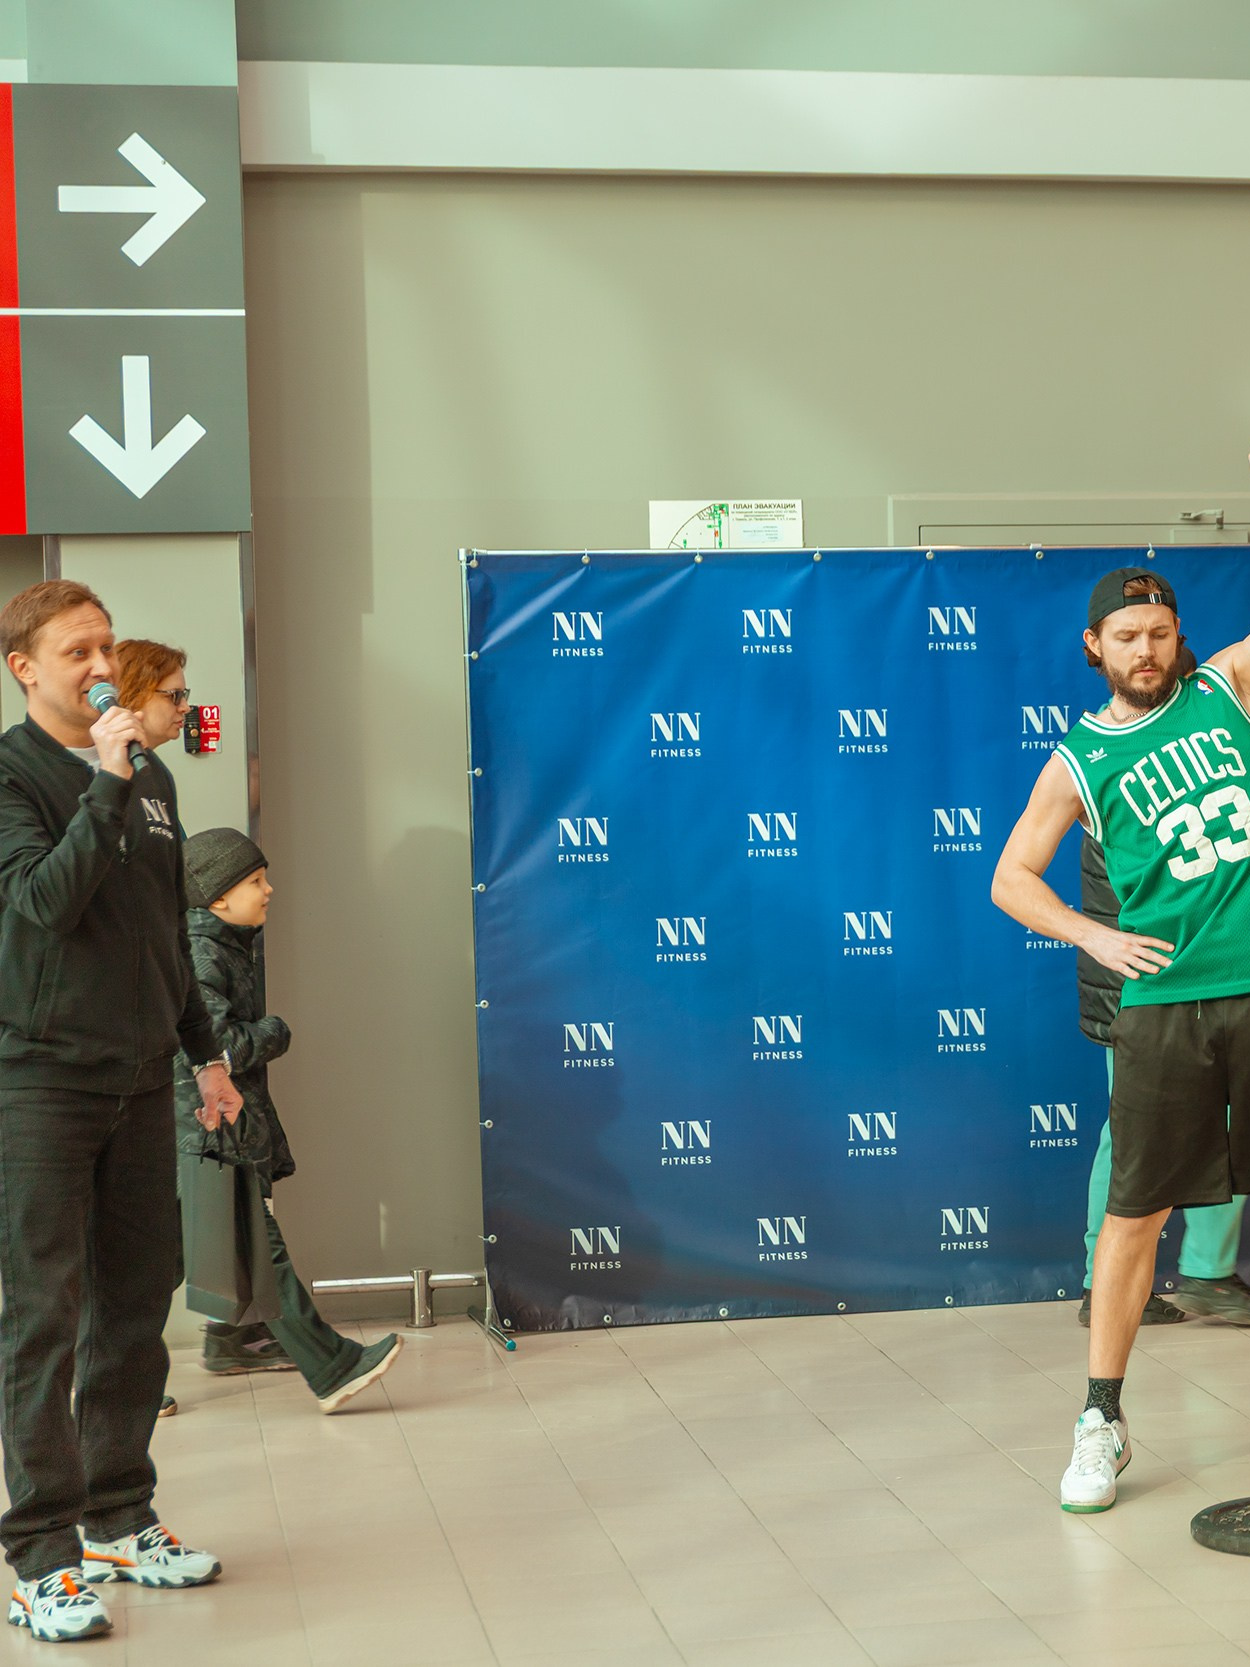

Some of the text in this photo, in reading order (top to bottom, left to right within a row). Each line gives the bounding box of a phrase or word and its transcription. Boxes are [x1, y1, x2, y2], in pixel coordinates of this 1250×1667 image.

[551, 611, 602, 641] NN
[742, 608, 792, 638] NN
[928, 606, 976, 635] NN
[552, 647, 604, 657] FITNESS
[742, 644, 793, 654] FITNESS
[928, 641, 977, 651] FITNESS
[203, 707, 219, 720] 01
[650, 712, 701, 742] NN
[839, 709, 888, 738] NN
[1022, 705, 1070, 734] NN
[650, 748, 702, 758] FITNESS
[838, 744, 888, 754] FITNESS
[1021, 740, 1062, 750] FITNE
[1119, 727, 1247, 826] CELTICS
[140, 797, 172, 827] NN
[933, 807, 982, 837] NN
[558, 817, 608, 847] NN
[748, 812, 798, 842] NN
[558, 853, 609, 863] FITNESS
[748, 847, 799, 858] FITNESS
[933, 842, 982, 852] FITNESS
[656, 916, 707, 947] NN
[844, 910, 893, 941] NN
[656, 952, 708, 963] FITNESS
[843, 946, 893, 956] FITNESS
[563, 1021, 615, 1053] NN
[752, 1014, 803, 1045] NN
[937, 1007, 986, 1038] NN
[752, 1050, 803, 1061] FITNESS
[937, 1042, 987, 1053] FITNESS
[563, 1057, 615, 1069] FITNESS
[848, 1111, 897, 1142] NN
[1030, 1103, 1078, 1133] NN
[660, 1119, 712, 1151] NN
[1030, 1137, 1078, 1148] FITNESS
[661, 1154, 713, 1166] FITNESS
[847, 1146, 898, 1157] FITNESS
[757, 1215, 807, 1247] NN
[940, 1206, 990, 1236] NN
[570, 1225, 621, 1256] NN
[940, 1240, 990, 1251] FITNESS
[570, 1260, 622, 1271] FITNESS
[758, 1250, 808, 1262] FITNESS
